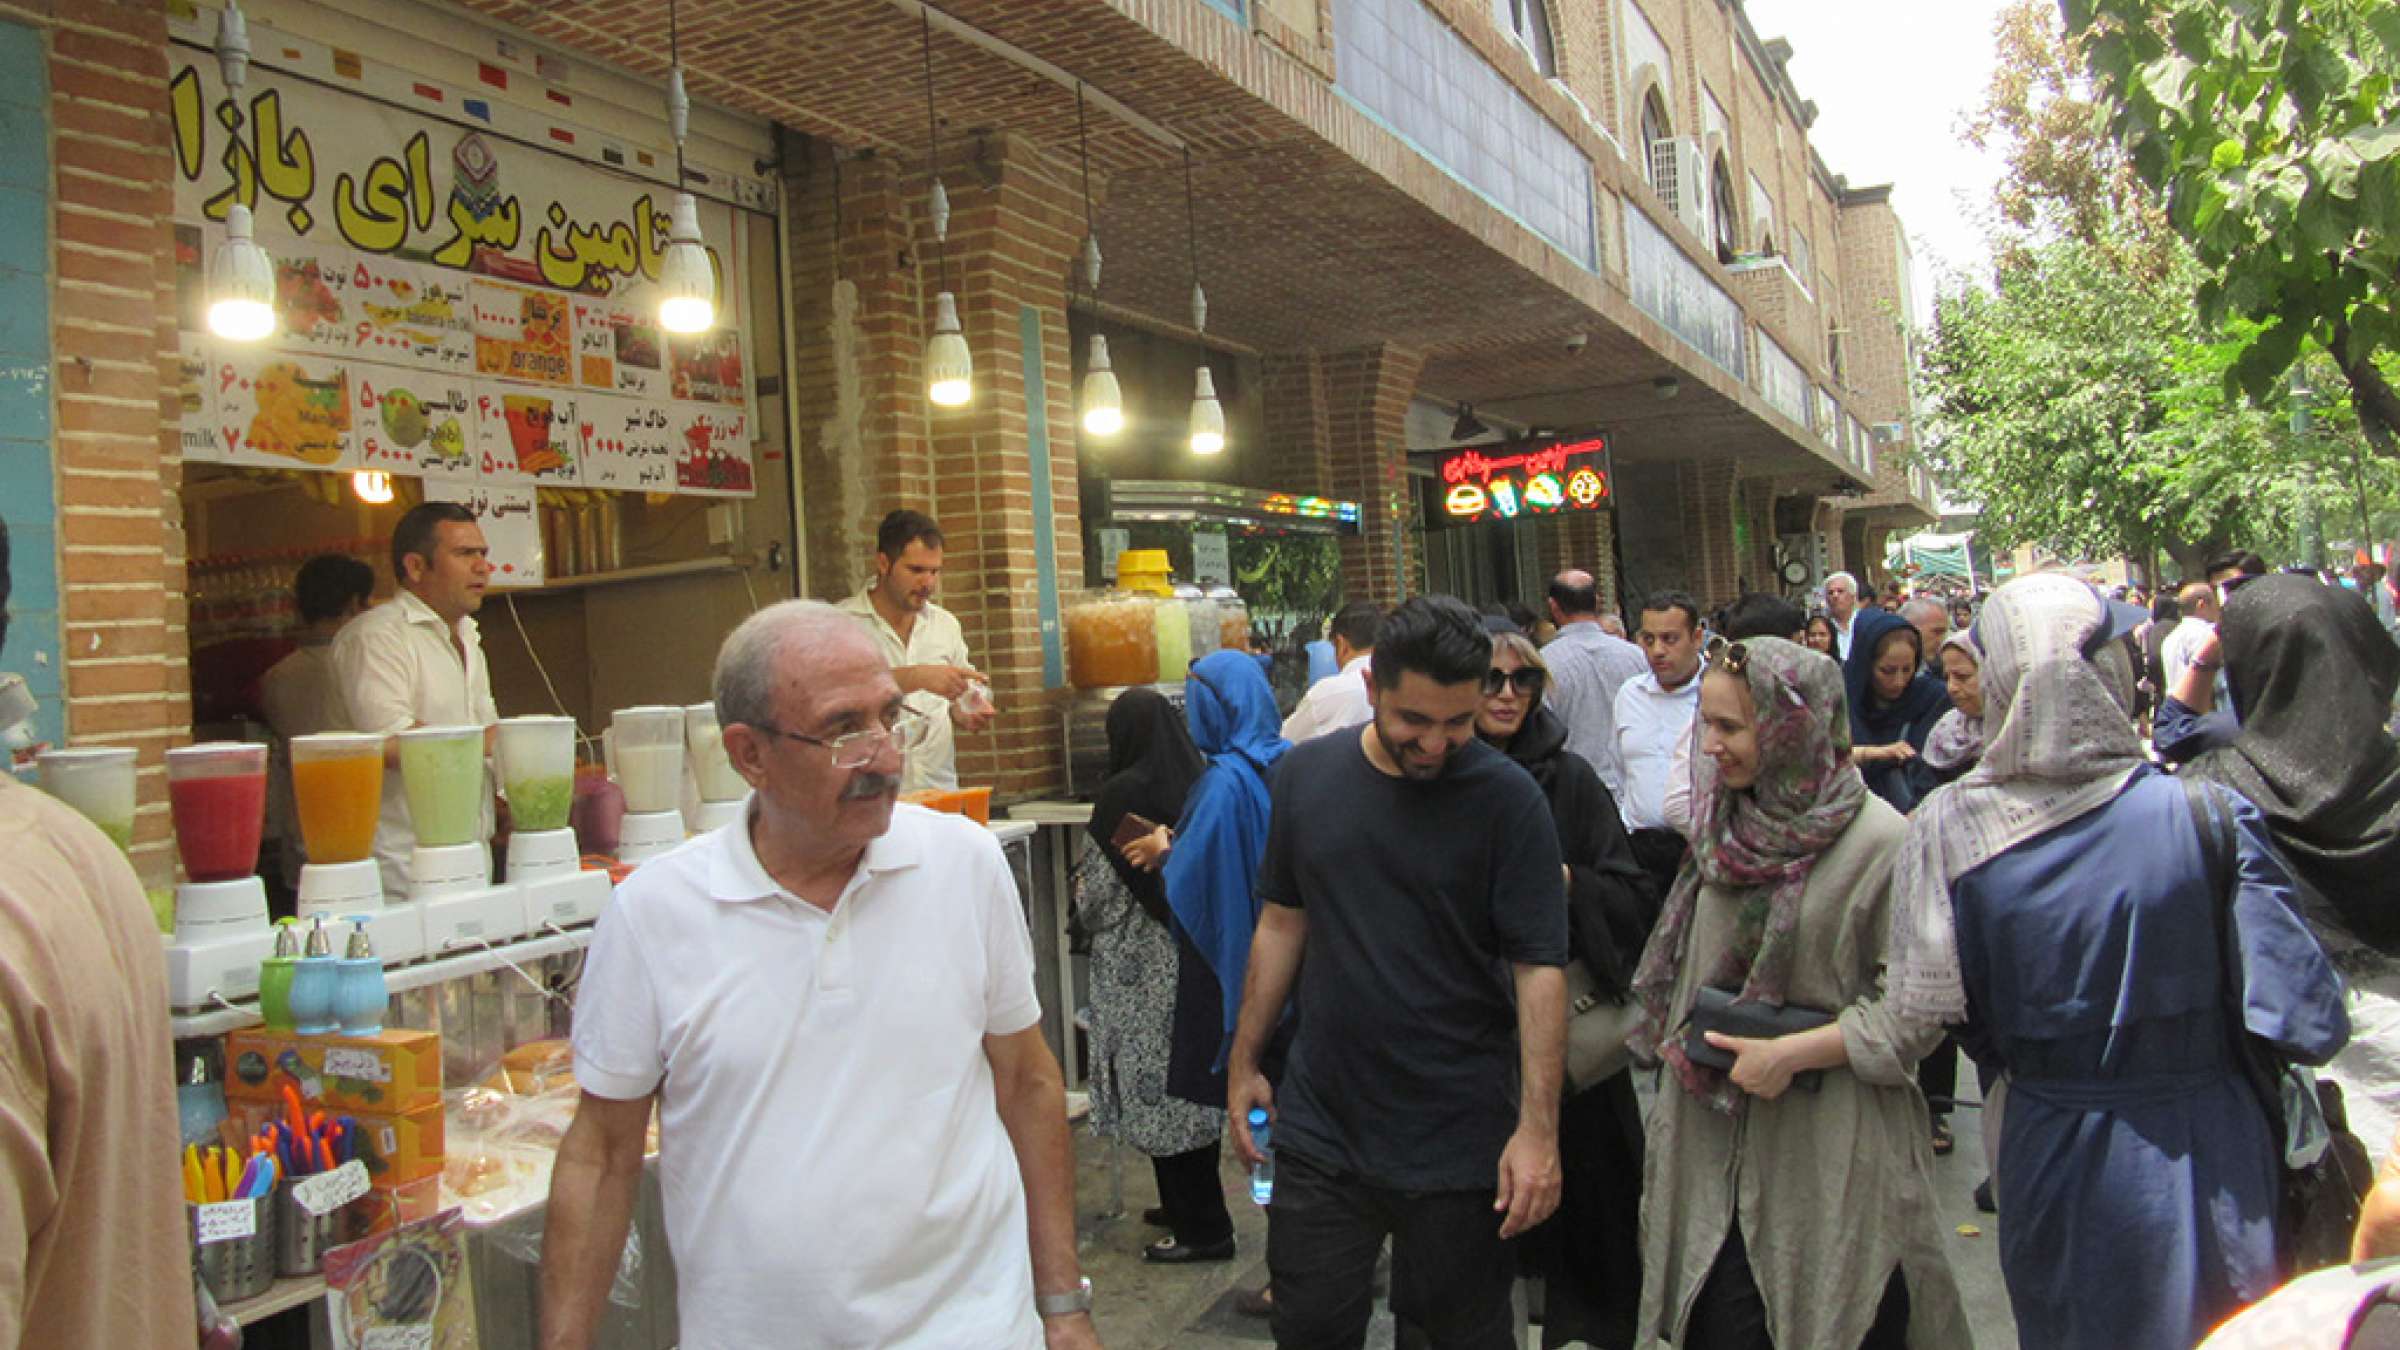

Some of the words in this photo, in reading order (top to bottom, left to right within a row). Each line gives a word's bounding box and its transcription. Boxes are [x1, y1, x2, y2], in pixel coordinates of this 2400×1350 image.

[333, 130, 521, 270] سرای
[510, 350, 565, 380] orange
[182, 429, 217, 449] milk
[491, 494, 531, 520] بستنی
